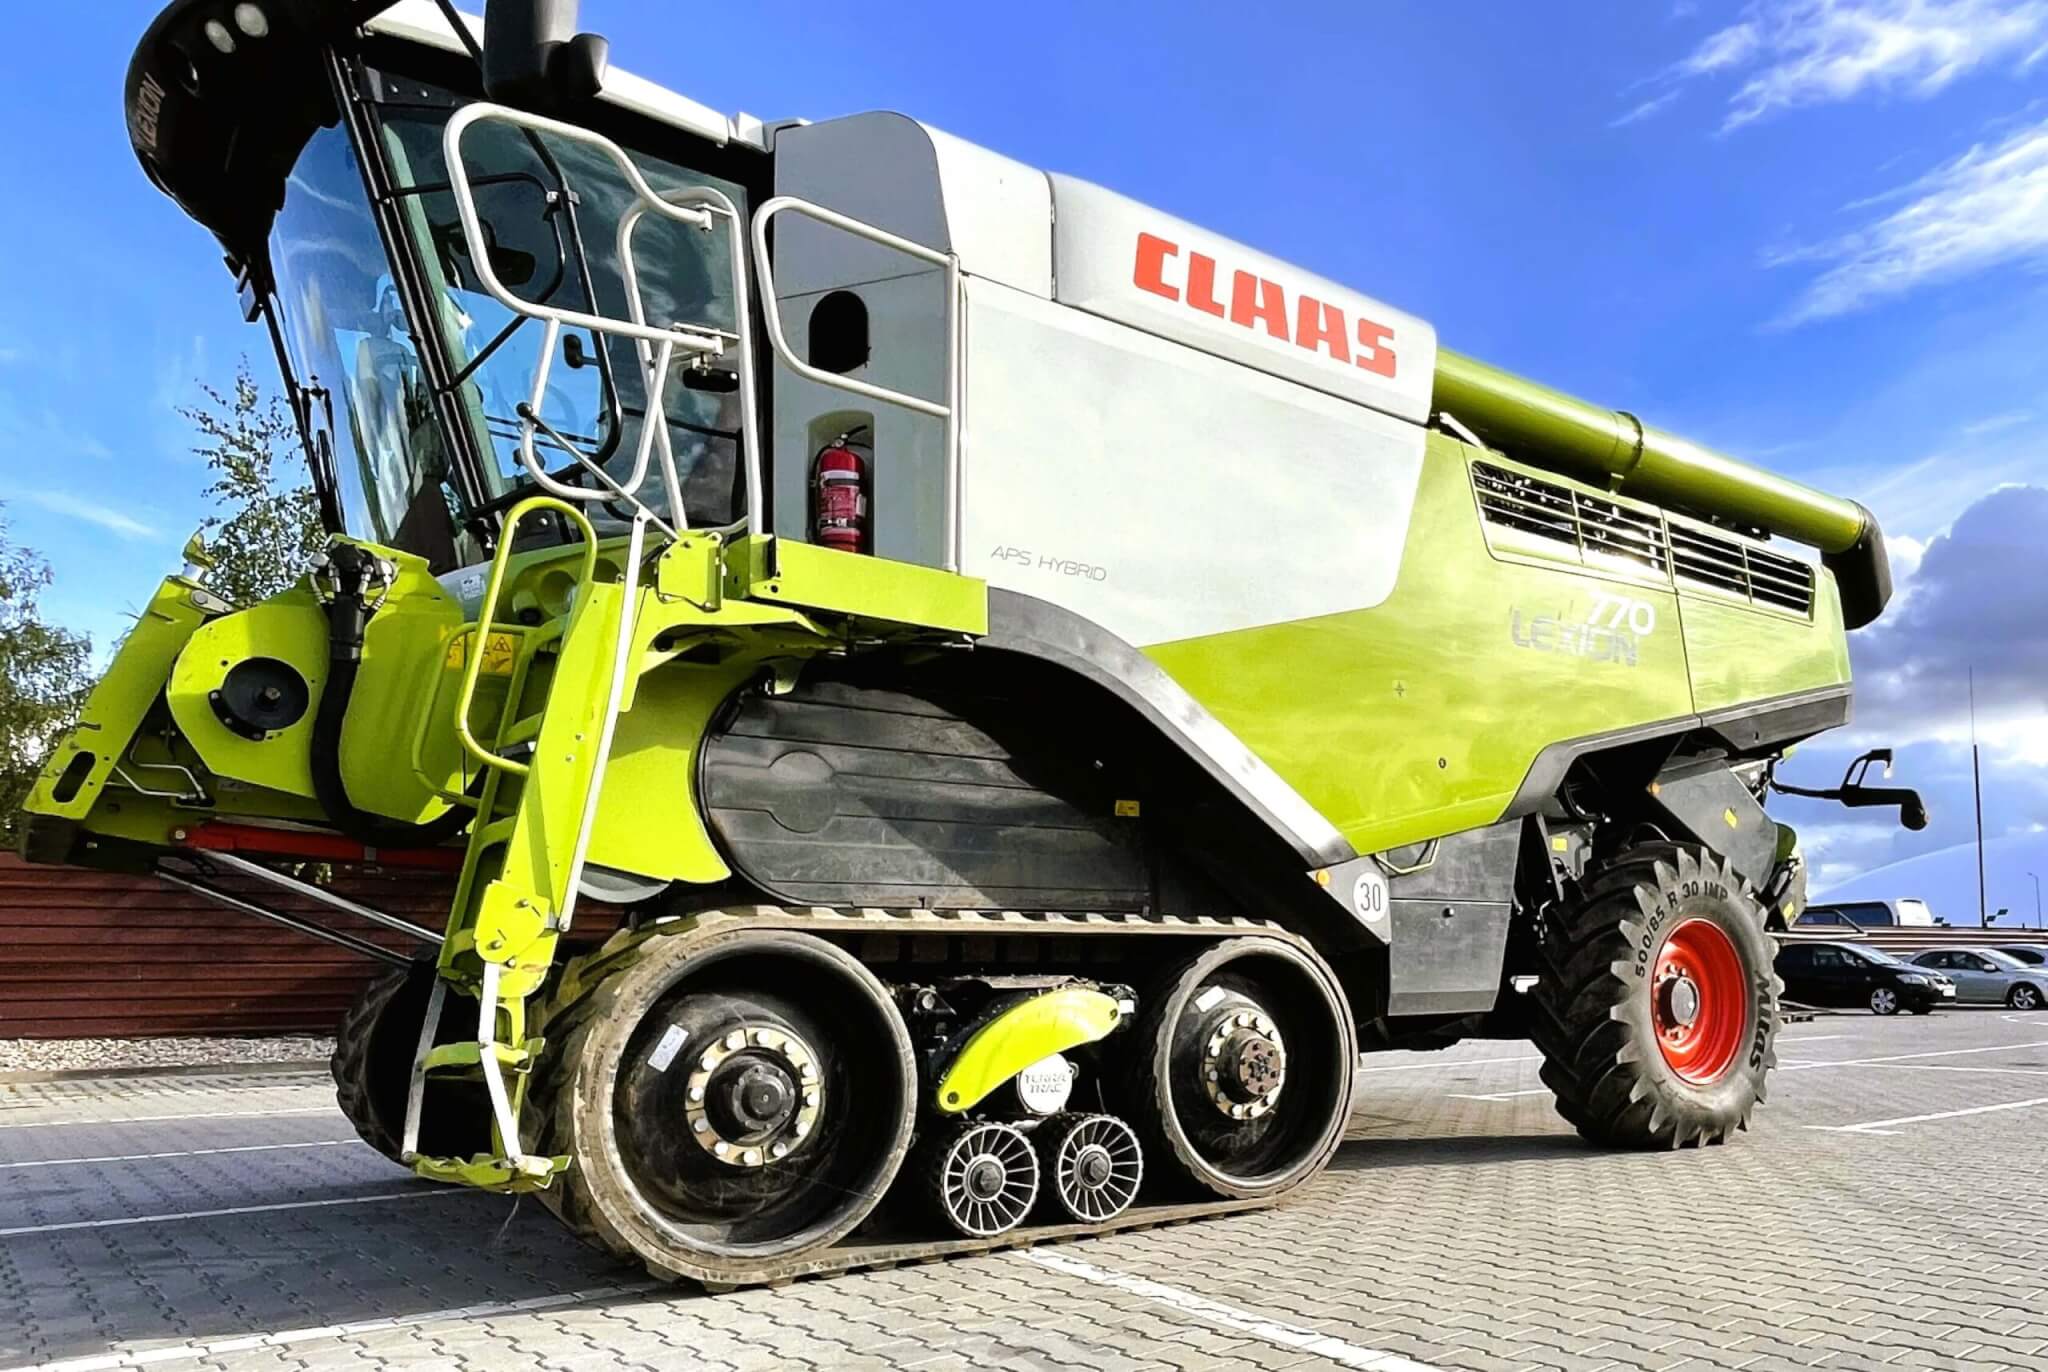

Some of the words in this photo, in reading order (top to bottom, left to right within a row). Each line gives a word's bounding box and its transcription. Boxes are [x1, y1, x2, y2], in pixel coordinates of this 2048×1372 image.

[1133, 231, 1396, 379] CLAAS
[990, 545, 1032, 566] APS
[1038, 555, 1107, 581] HYBRID
[1511, 609, 1637, 667] LEXION
[1588, 591, 1656, 636] 770
[1360, 882, 1381, 912] 30
[1635, 905, 1665, 978] 500/85
[1668, 891, 1678, 908] R
[1682, 881, 1699, 898] 30
[1704, 880, 1728, 901] IMP
